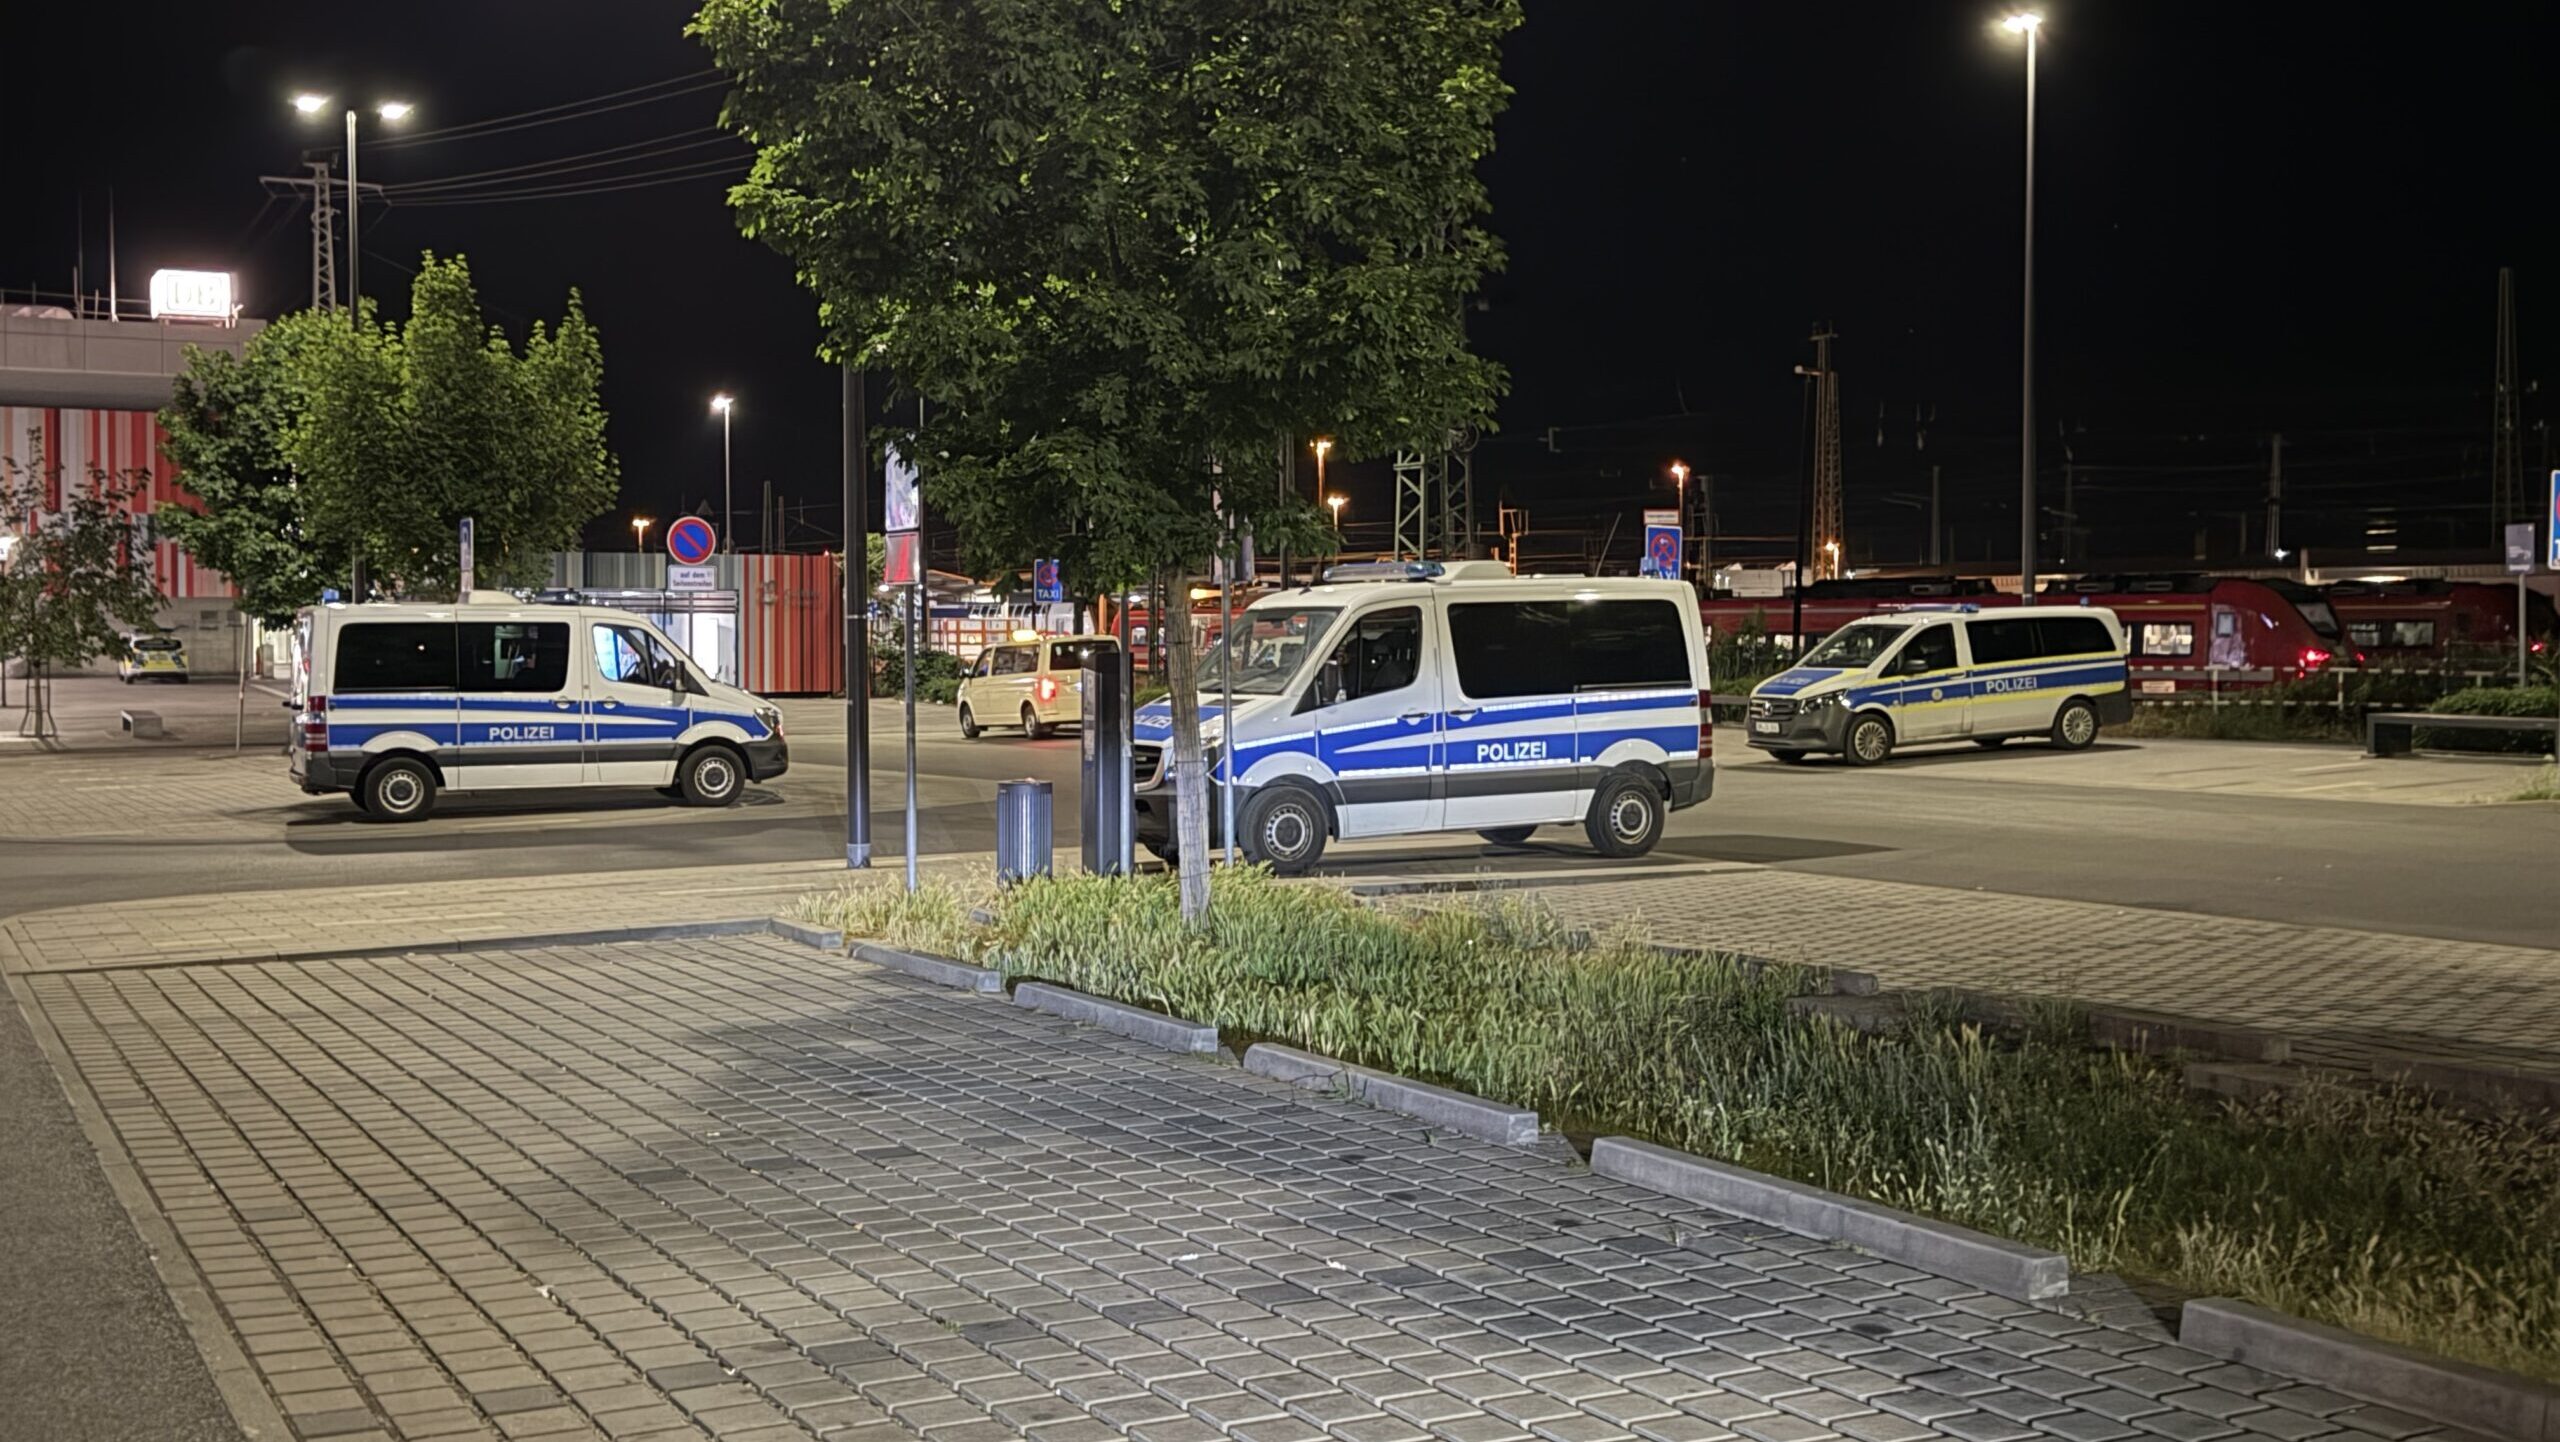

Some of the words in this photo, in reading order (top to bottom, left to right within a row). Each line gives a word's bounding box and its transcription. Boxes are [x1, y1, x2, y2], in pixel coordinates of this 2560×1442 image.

[175, 281, 215, 305] DB
[1038, 589, 1059, 599] TAXI
[1985, 676, 2037, 693] POLIZEI
[489, 725, 555, 741] POLIZEI
[1476, 740, 1547, 762] POLIZEI
